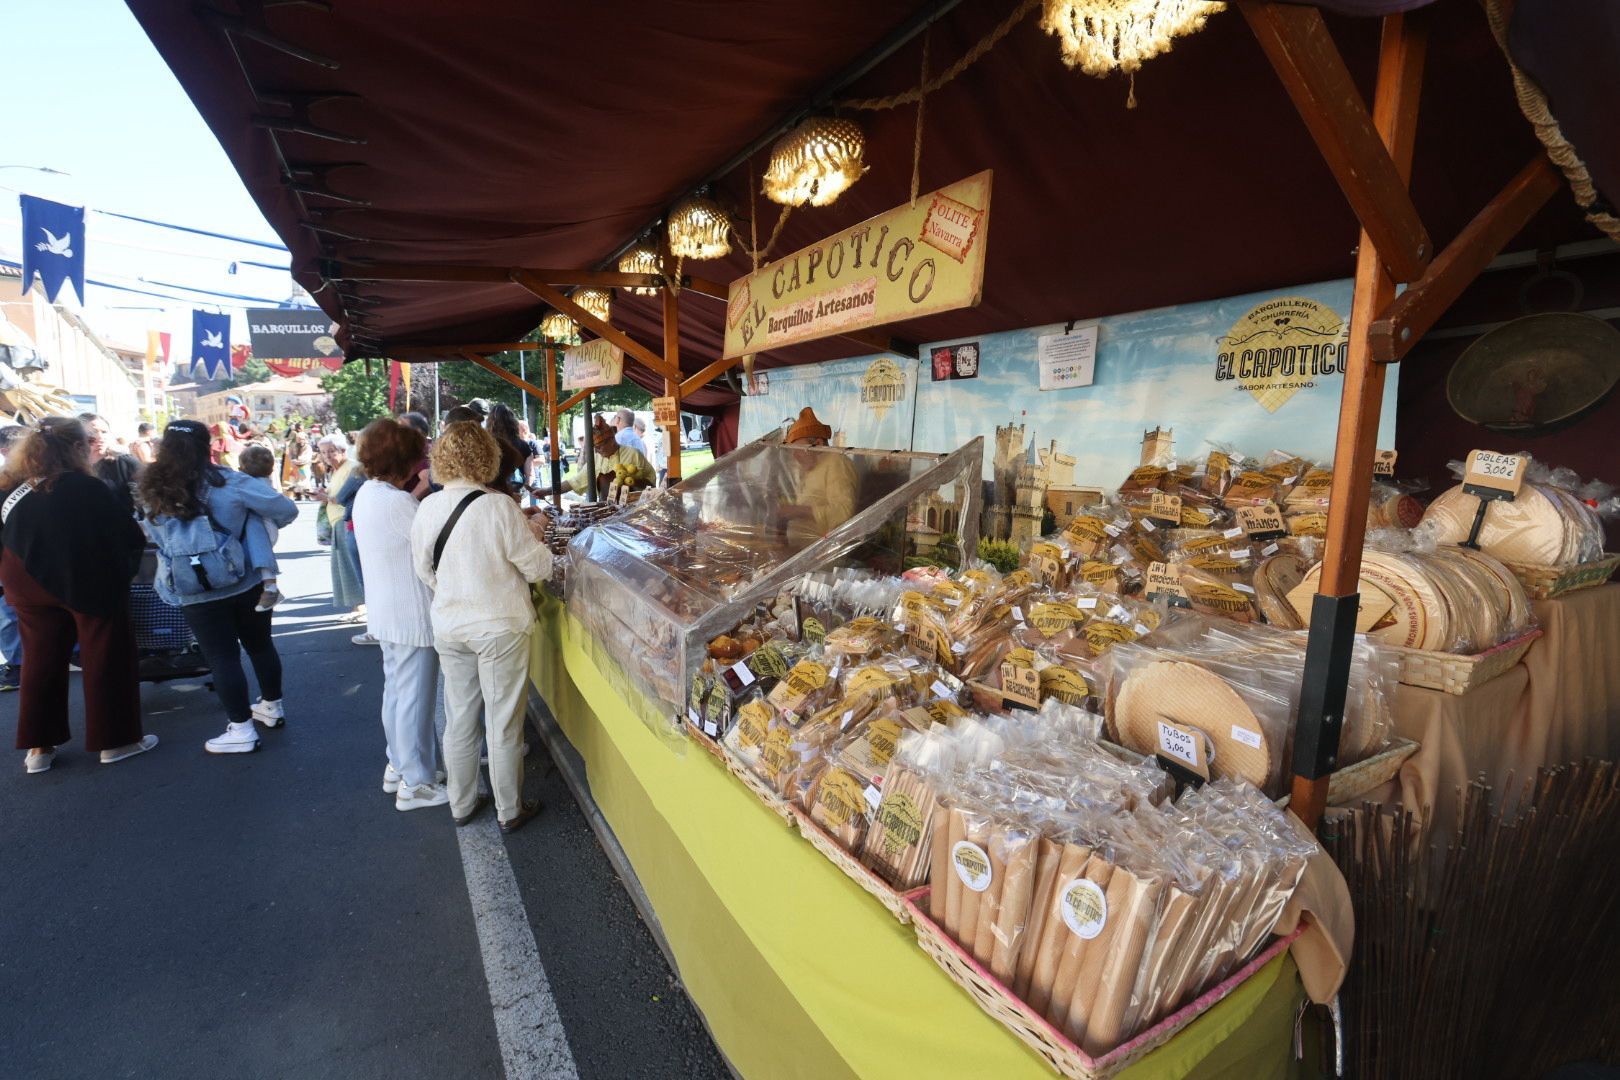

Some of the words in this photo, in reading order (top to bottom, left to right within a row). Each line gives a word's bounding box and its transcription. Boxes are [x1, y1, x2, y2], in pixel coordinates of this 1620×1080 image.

[937, 203, 970, 229] OLITE
[928, 220, 963, 249] Navarra
[740, 298, 767, 350] EL
[771, 224, 936, 305] CAPOTICO
[767, 307, 814, 335] Barquillos
[815, 288, 876, 319] Artesanos
[1247, 299, 1319, 321] BARQUILLERÍA
[251, 324, 325, 335] BARQUILLOS
[1215, 351, 1236, 381] EL
[1238, 340, 1348, 380] CAPOTICO
[1476, 451, 1516, 466] OBLEAS
[1246, 516, 1280, 530] MANGO
[1162, 724, 1192, 744] TUBOS
